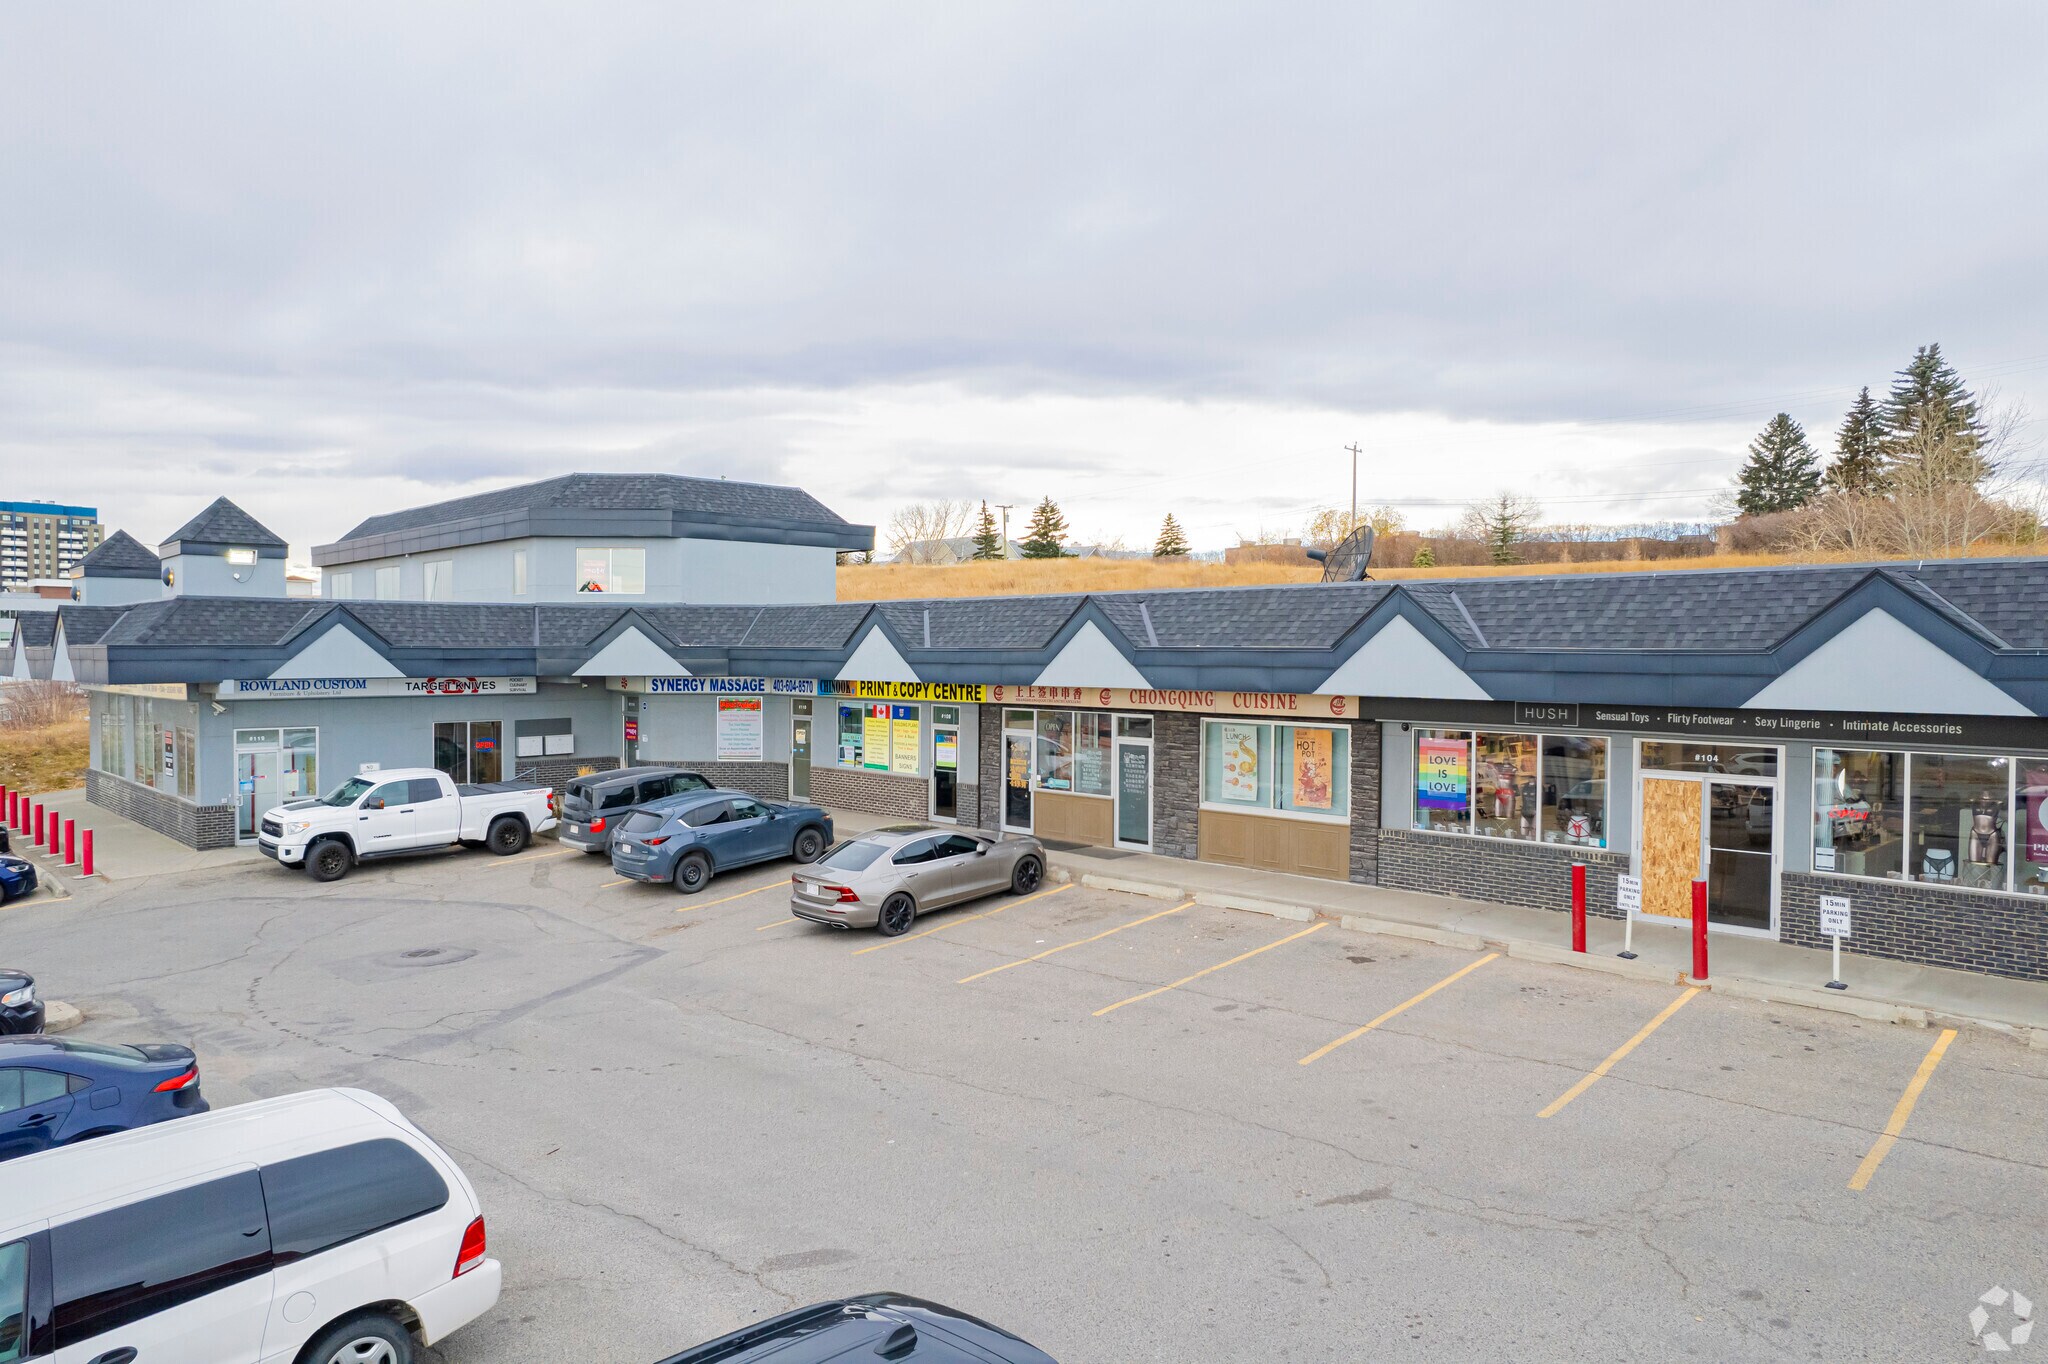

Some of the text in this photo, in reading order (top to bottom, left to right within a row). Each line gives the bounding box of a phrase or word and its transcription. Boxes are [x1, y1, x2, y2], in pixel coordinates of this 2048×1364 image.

[240, 679, 367, 691] ROWLAND CUSTOM
[405, 681, 496, 691] TARGET KNIVES
[652, 678, 765, 692] SYNERGY MASSAGE
[820, 680, 851, 693] CHINOOK
[860, 680, 982, 701] PRINT & COPY CENTRE
[1129, 689, 1297, 710] CHONGQING CUISINE
[1525, 707, 1568, 720] HUSH
[1045, 723, 1060, 731] OPEN
[1595, 711, 1962, 735] Sensual Toys Flirty Footwear Sexy Lingerie Intimate Accessories
[475, 741, 494, 749] OPEN
[1297, 741, 1315, 750] HOT
[1429, 755, 1456, 766] LOVE
[1694, 754, 1719, 762] #104
[1438, 769, 1447, 778] IS
[1429, 782, 1456, 792] LOVE
[1828, 809, 1869, 820] OPEN
[1620, 886, 1640, 894] PARKING
[1822, 909, 1848, 917] PARKING
